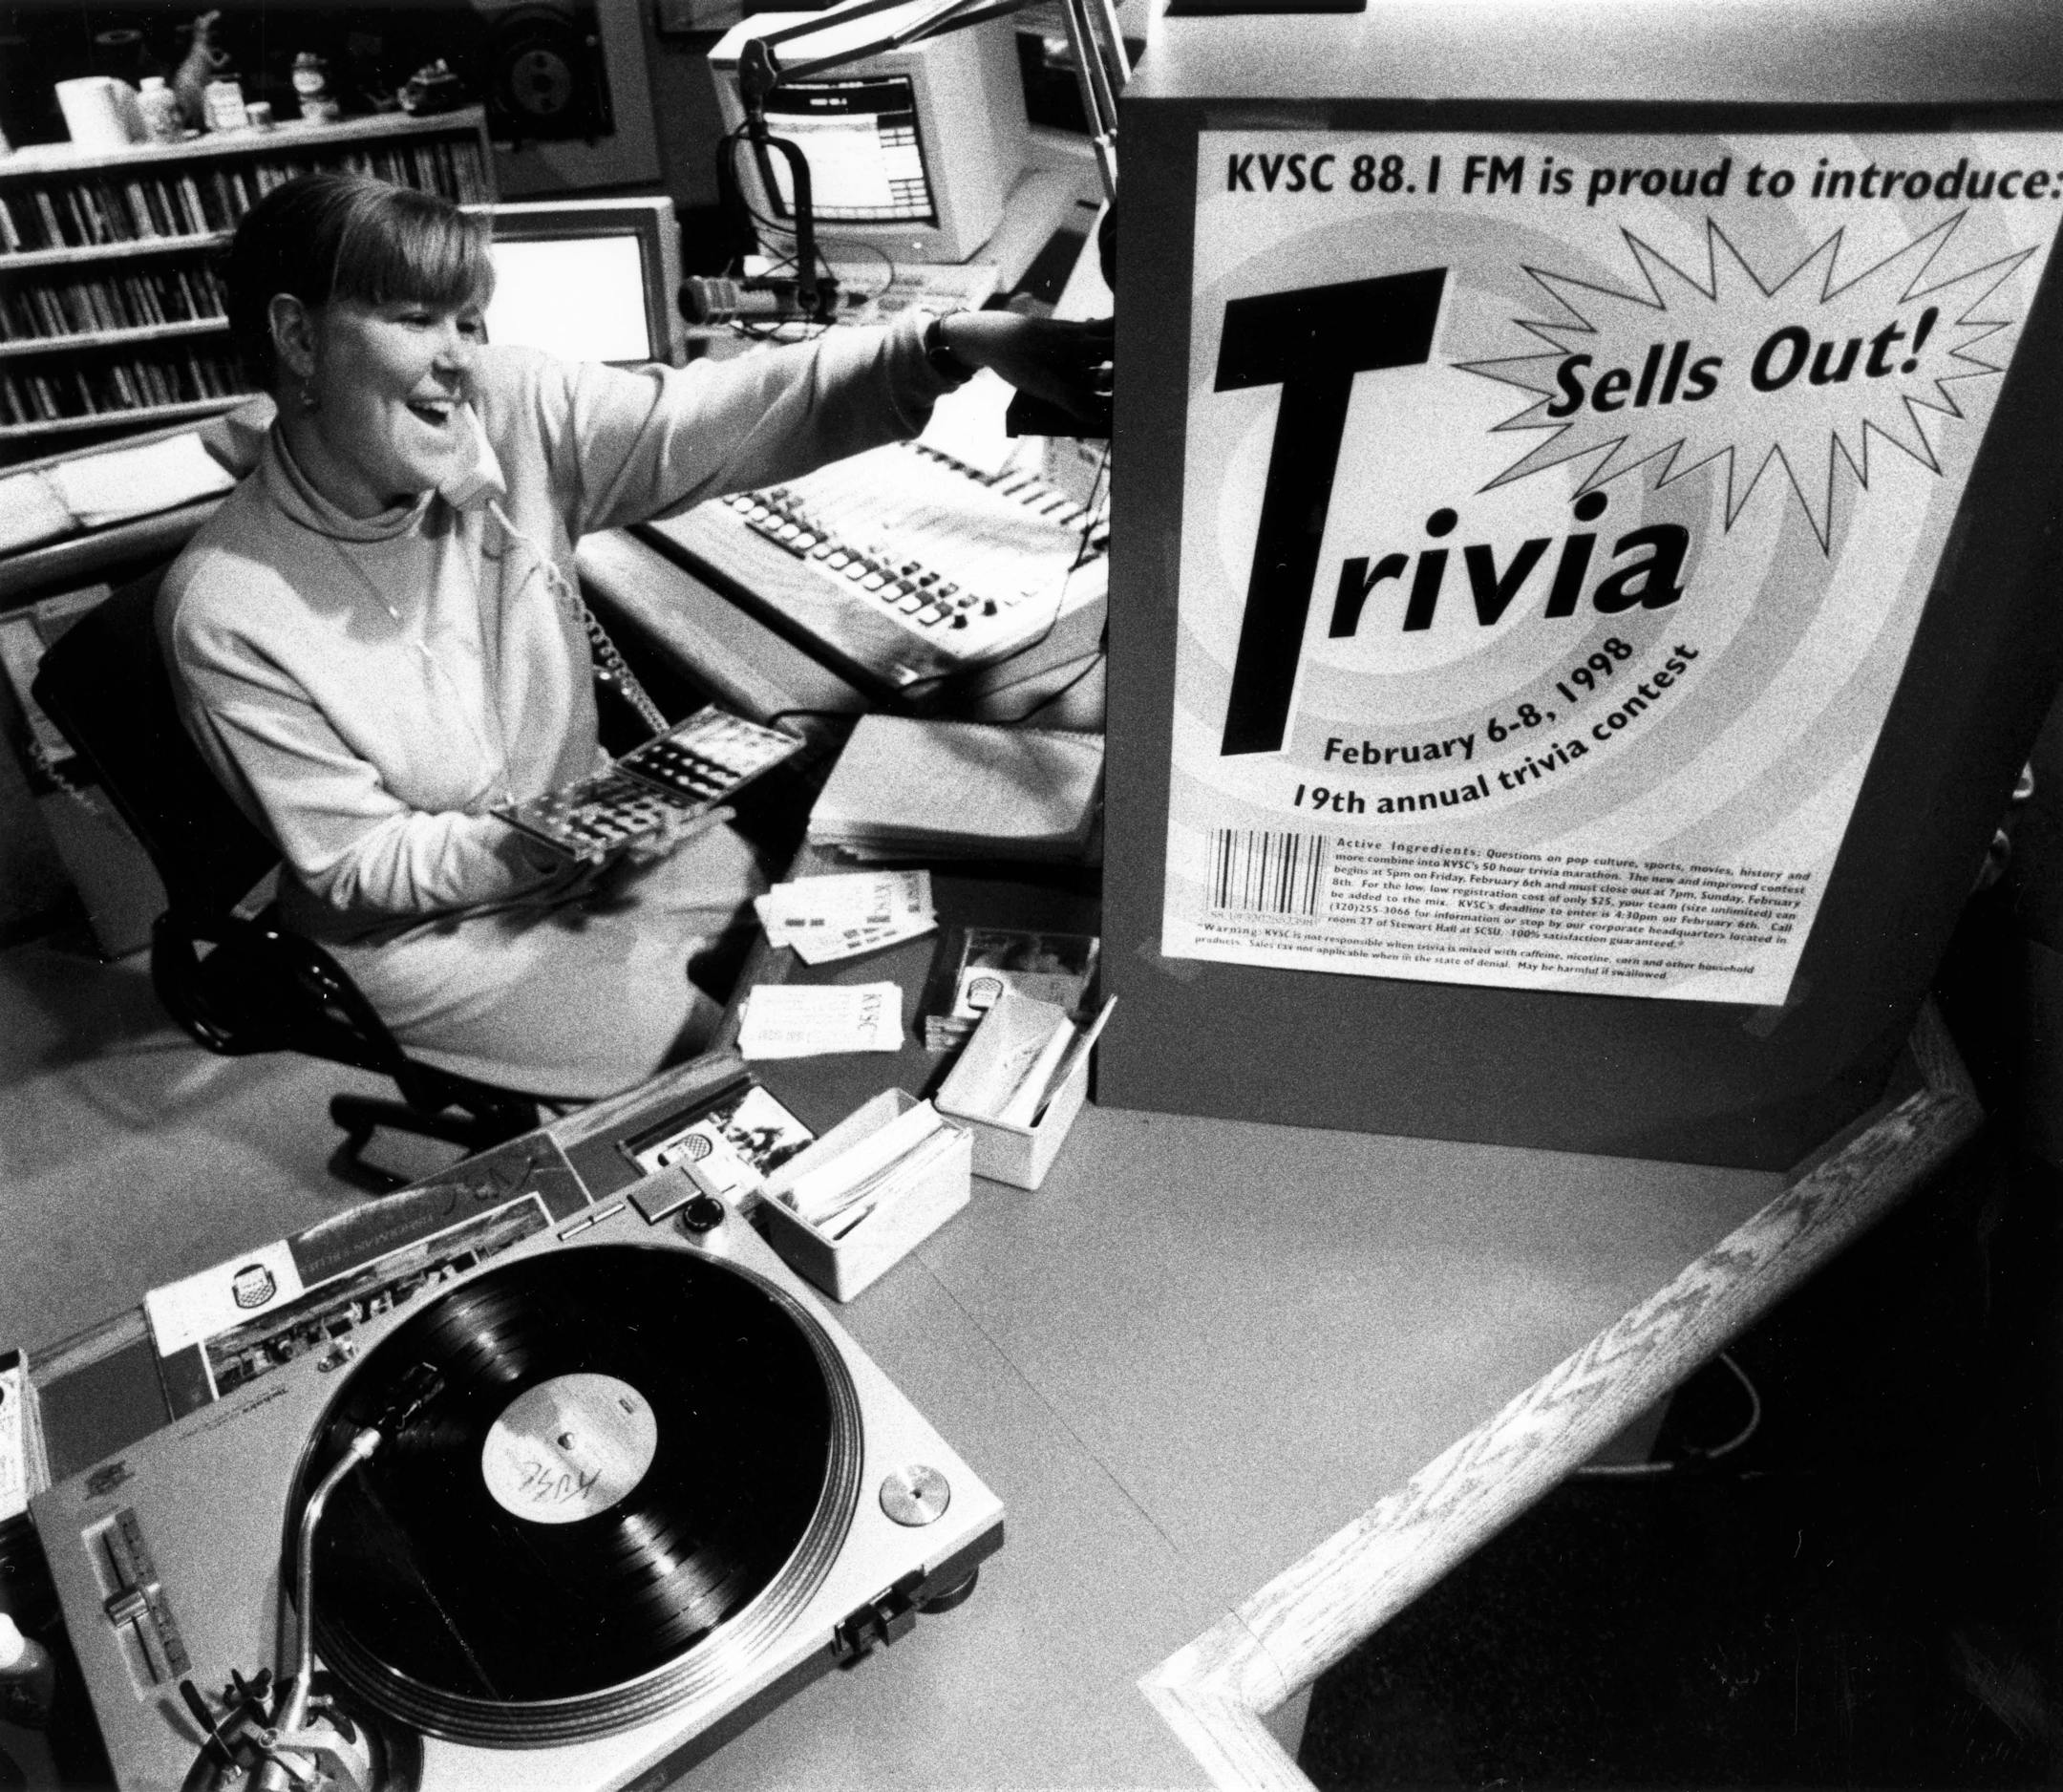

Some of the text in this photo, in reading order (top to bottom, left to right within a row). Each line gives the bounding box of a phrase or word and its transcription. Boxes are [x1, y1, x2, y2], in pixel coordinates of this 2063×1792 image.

[1226, 153, 2063, 206] KVSC 88.1 FM is proud to introduce:
[1547, 307, 1940, 417] Sells Out!
[1213, 267, 1690, 757] Trivia
[1324, 636, 1634, 766] February 6-8, 1998
[1294, 643, 1699, 814] 19th annual trivia contest
[1335, 853, 1364, 862] more
[1367, 854, 1414, 865] combine
[1417, 856, 1440, 867] into
[1482, 861, 1497, 871] 50
[1499, 862, 1525, 873] hour
[1529, 864, 1560, 876] trivia
[1562, 868, 1622, 881] marathon.
[1628, 871, 1649, 883] The
[1651, 876, 1675, 885] new
[1678, 876, 1700, 886] and
[1702, 877, 1758, 891] improved
[1760, 883, 1806, 894] contest
[1336, 838, 1383, 850] Active
[1391, 842, 1481, 857] Ingredients:
[1486, 847, 1542, 862] Questions
[1566, 856, 1589, 867] pop
[1593, 856, 1638, 869] culture,
[1643, 861, 1685, 873] sports,
[1690, 864, 1733, 877] movies,
[1739, 866, 1782, 882] history
[1787, 871, 1811, 882] and
[1333, 863, 1369, 876] begins
[1372, 866, 1383, 877] at
[1386, 867, 1411, 880] 5pm
[1469, 873, 1520, 888] February
[1522, 877, 1542, 888] 6th
[1544, 880, 1566, 889] and
[1568, 882, 1598, 892] must
[1600, 883, 1628, 894] close
[1631, 885, 1650, 896] out
[1653, 886, 1665, 897] at
[1670, 887, 1697, 901] 7pm,
[1748, 894, 1801, 910] February
[1361, 878, 1379, 889] For
[1383, 880, 1402, 891] the
[1430, 884, 1450, 894] low
[1452, 886, 1518, 900] registration
[1521, 891, 1544, 902] cost
[1548, 892, 1563, 903] of
[1563, 894, 1587, 907] only
[1590, 895, 1615, 907] $25,
[1619, 900, 1645, 909] your
[1648, 899, 1678, 911] team
[1682, 902, 1709, 914] (size
[1776, 911, 1797, 920] can
[1328, 915, 1357, 925] room
[1360, 915, 1373, 926] 27
[1376, 917, 1388, 928] of
[1390, 918, 1433, 931] Stewart
[1436, 922, 1457, 933] Hall
[1459, 924, 1471, 934] at
[1510, 927, 1541, 939] 100%
[1542, 929, 1606, 943] satisfaction
[1330, 888, 1345, 899] be
[1348, 890, 1382, 902] added
[1386, 892, 1399, 904] to
[1403, 894, 1421, 905] the
[1499, 901, 1546, 914] deadline
[1550, 905, 1563, 915] to
[1566, 907, 1599, 918] enter
[1601, 908, 1610, 919] is
[1662, 915, 1677, 924] on
[1681, 914, 1733, 930] February
[1771, 921, 1793, 932] Call
[1414, 907, 1431, 918] for
[1435, 909, 1499, 924] information
[1520, 916, 1545, 929] stop
[1548, 917, 1563, 930] by
[1589, 923, 1645, 934] corporate
[1648, 925, 1726, 940] headquarters
[1729, 930, 1773, 943] located
[1776, 934, 1787, 945] in
[1248, 939, 1274, 949] Sales
[1277, 941, 1293, 951] tax
[1296, 944, 1314, 953] not
[1316, 946, 1370, 958] applicable
[1372, 949, 1400, 960] when
[1401, 951, 1413, 961] in
[1414, 952, 1433, 963] the
[1435, 955, 1461, 965] state
[1464, 957, 1475, 967] of
[1518, 961, 1538, 973] May
[1542, 963, 1555, 972] be
[1557, 964, 1600, 975] harmful
[1601, 967, 1609, 976] if
[1265, 928, 1289, 938] KVSC
[1292, 930, 1302, 940] is
[1305, 932, 1322, 942] not
[1325, 935, 1384, 947] responsible
[1386, 939, 1414, 949] when
[1417, 941, 1446, 951] trivia
[1447, 943, 1457, 952] is
[1458, 945, 1491, 955] mixed
[1494, 947, 1519, 957] with
[1616, 957, 1641, 966] corn
[1643, 958, 1664, 968] and
[1665, 959, 1696, 970] other
[1697, 962, 1755, 974] household
[858, 993, 882, 1031] KVSC
